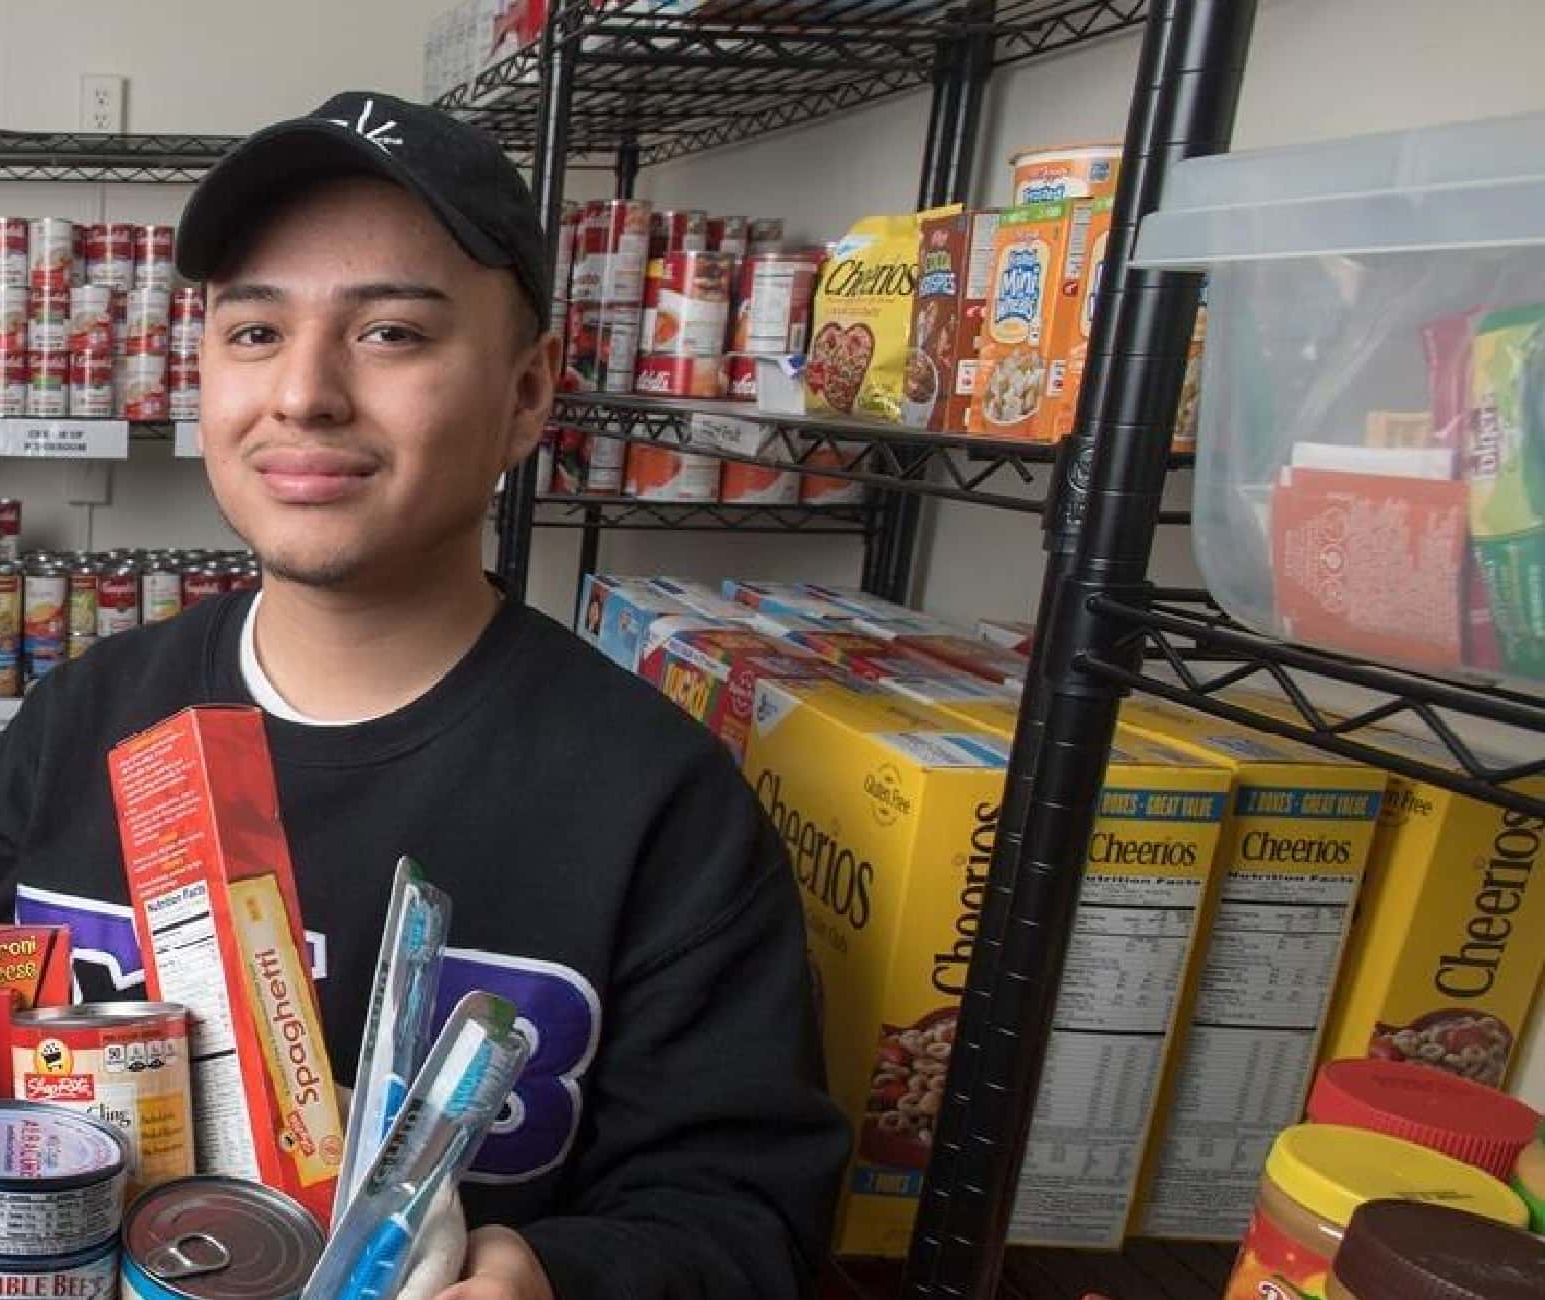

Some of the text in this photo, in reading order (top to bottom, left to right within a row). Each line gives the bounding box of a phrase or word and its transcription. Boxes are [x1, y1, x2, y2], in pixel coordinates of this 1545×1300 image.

[821, 256, 919, 299] Cheerios
[1088, 832, 1198, 867] Cheerios
[1242, 831, 1353, 865] Cheerios
[1087, 875, 1152, 887] utrition
[1433, 809, 1545, 998] Cheerios
[257, 948, 322, 1108] Spaghetti
